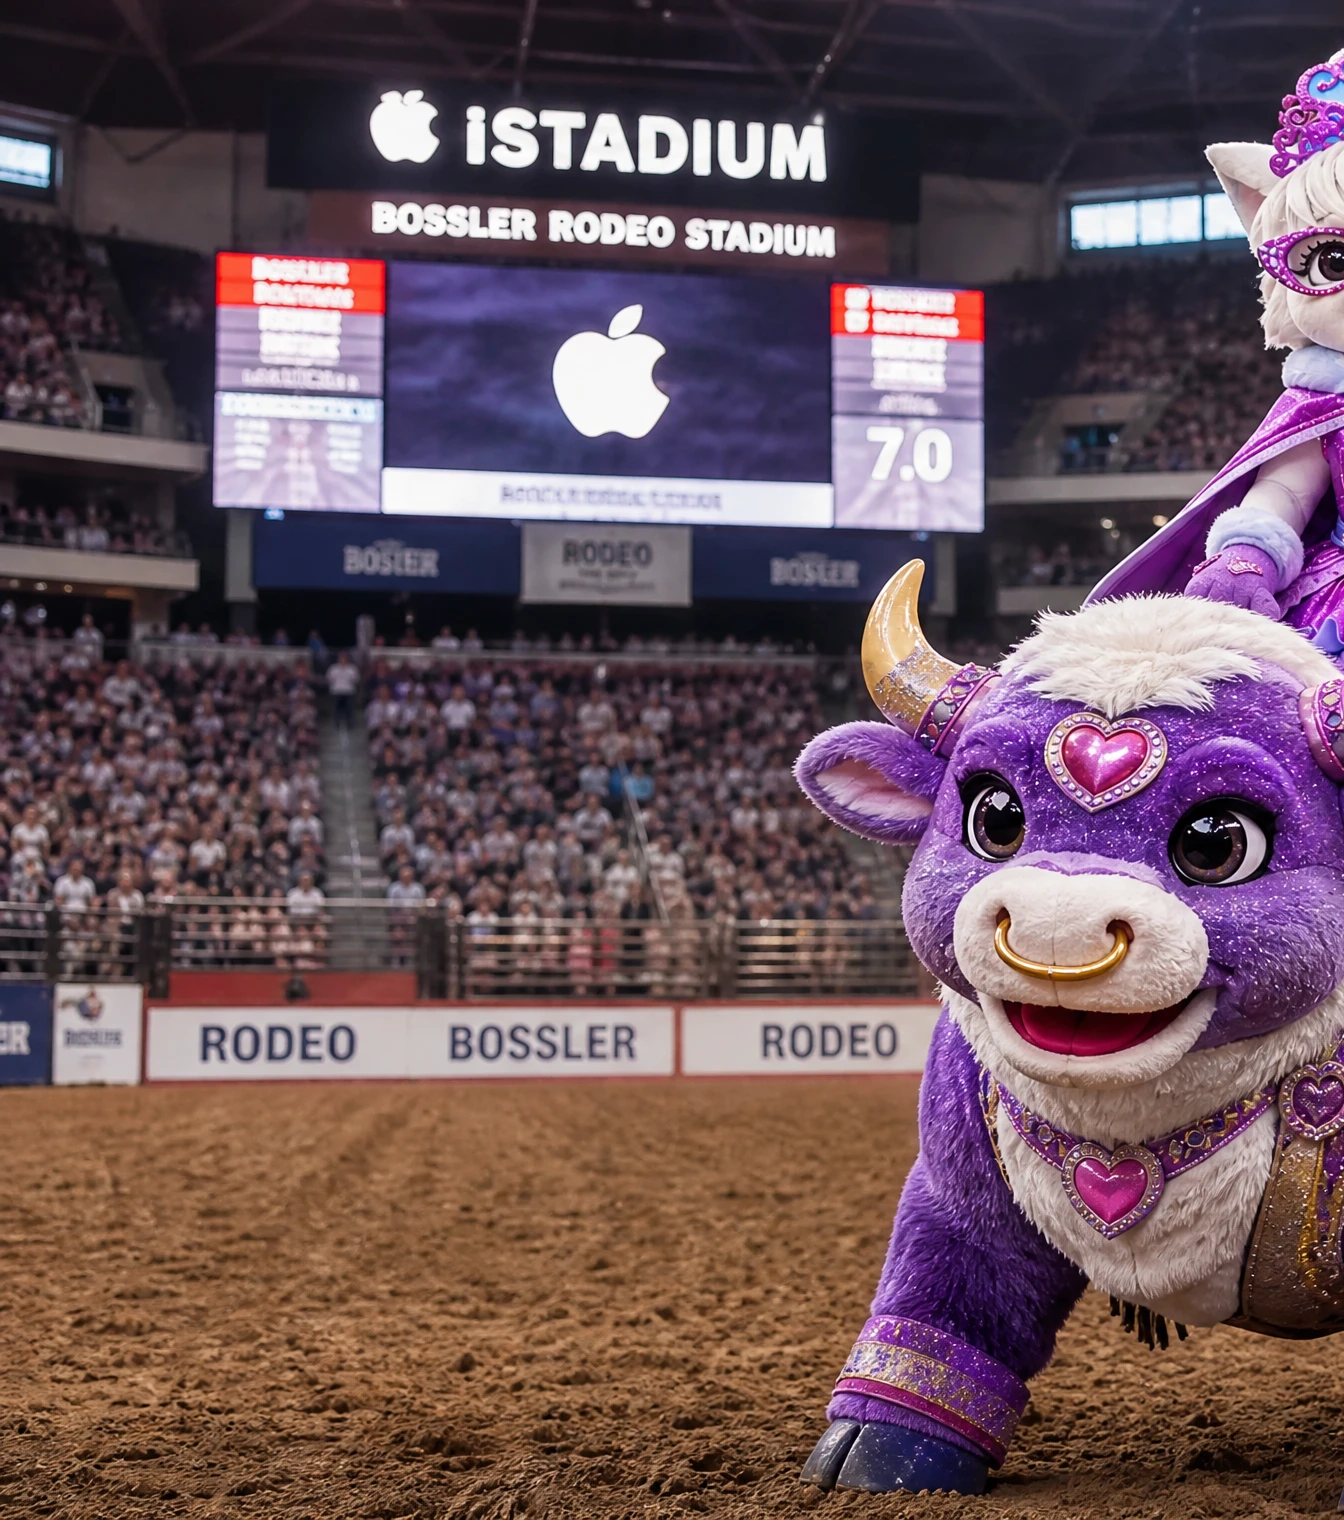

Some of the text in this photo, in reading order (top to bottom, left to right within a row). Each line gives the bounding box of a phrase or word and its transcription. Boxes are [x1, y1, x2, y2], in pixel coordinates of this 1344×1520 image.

[466, 106, 827, 182] iSTADIUM
[372, 201, 836, 258] BOSSLER RODEO STADIUM
[866, 426, 953, 483] 7.0
[561, 538, 653, 568] RODEO
[199, 1024, 356, 1063] RODEO
[448, 1023, 637, 1061] BOSSLER
[760, 1022, 898, 1060] RODEO
